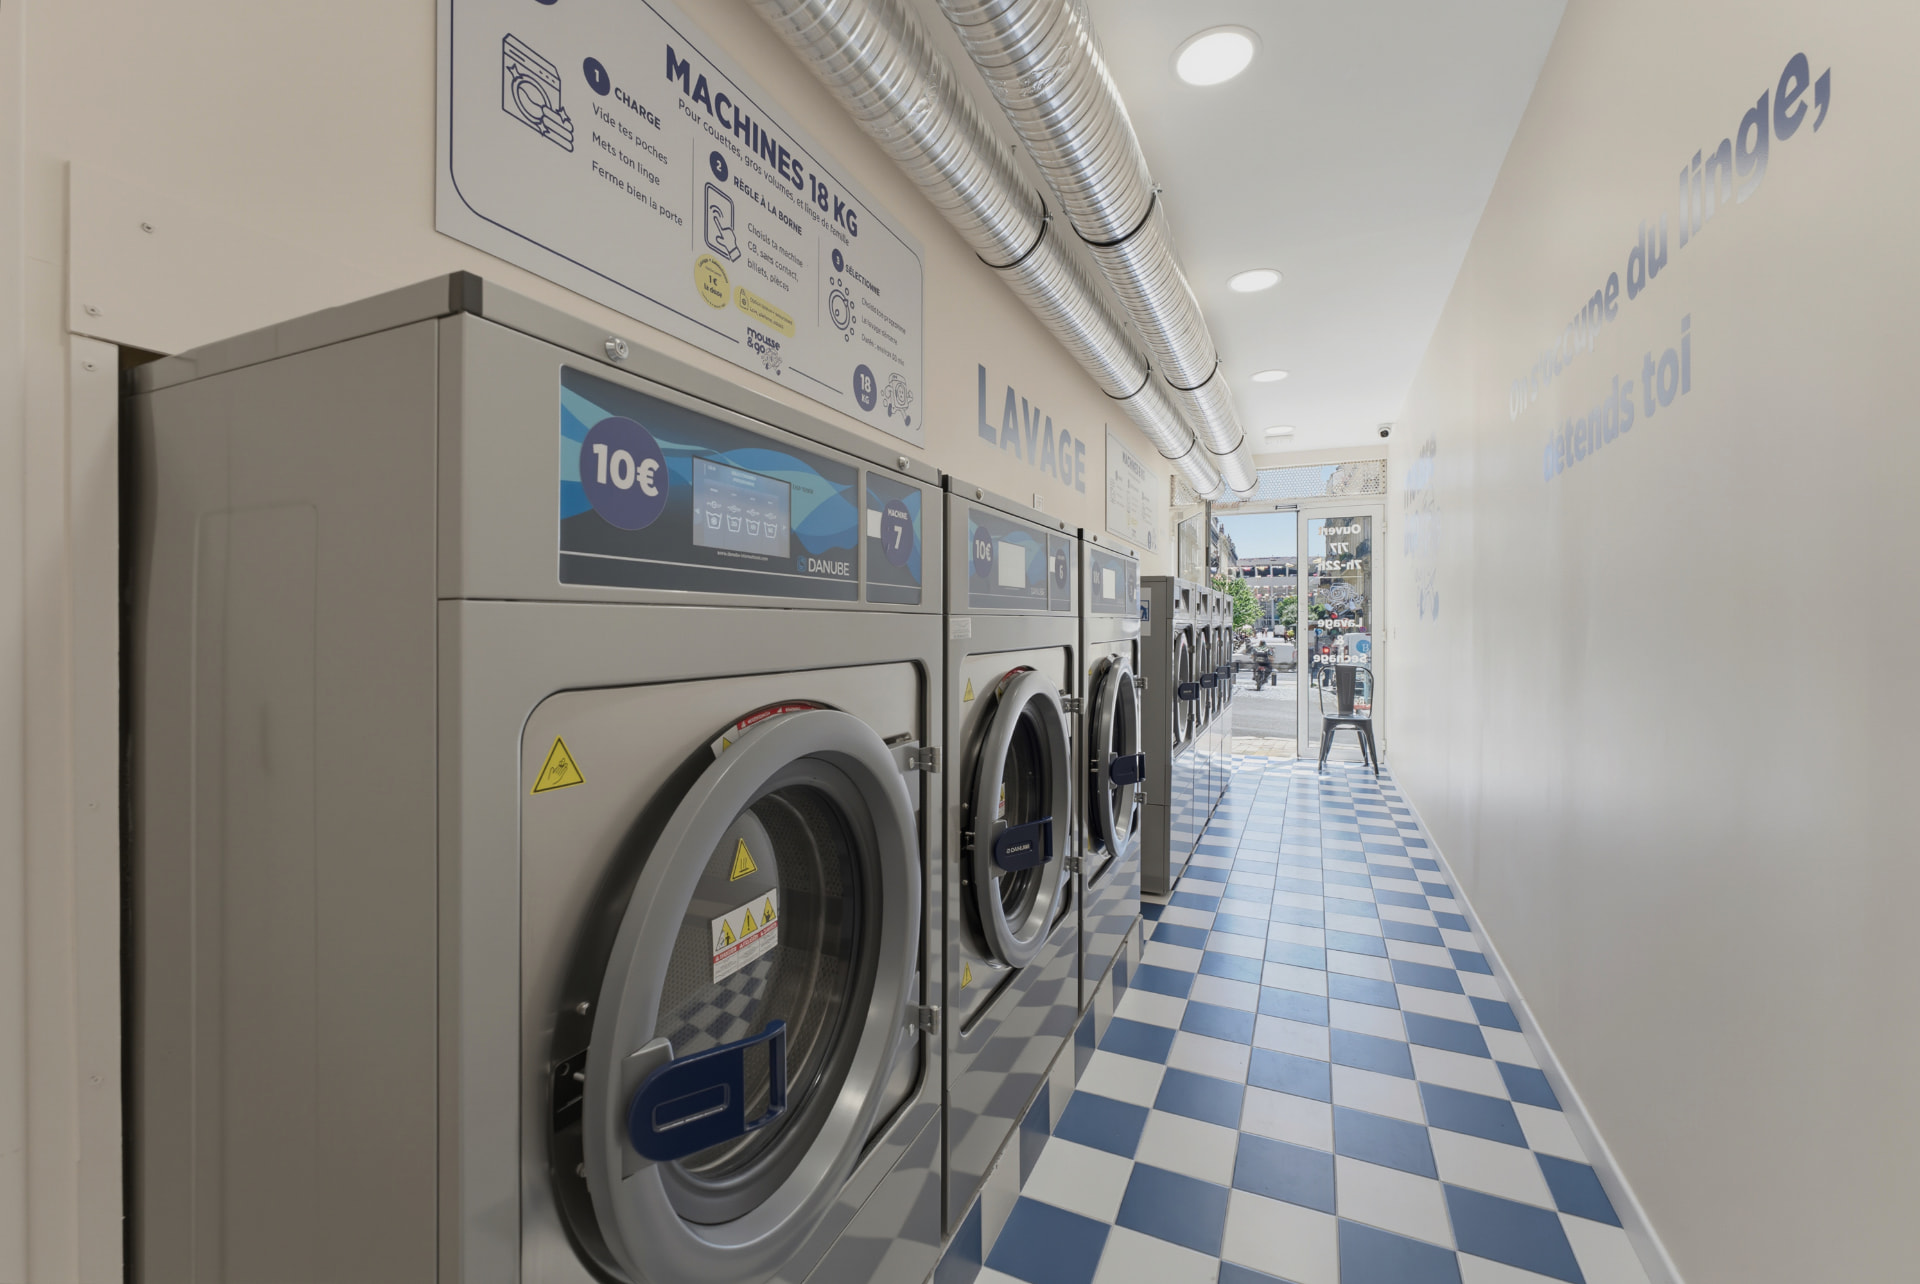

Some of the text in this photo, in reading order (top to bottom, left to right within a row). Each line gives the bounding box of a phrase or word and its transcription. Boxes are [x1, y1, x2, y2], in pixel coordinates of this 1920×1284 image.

[594, 69, 600, 82] 1
[614, 87, 661, 130] CHARGE
[592, 102, 668, 165] Vide tes poches
[666, 43, 858, 237] MACHINES 18 KG
[592, 131, 660, 186] Mets ton linge
[679, 97, 850, 246] Pour couettes, gros volumes, et linge de famille
[716, 160, 722, 172] 2
[1627, 210, 1668, 300] du
[1679, 52, 1831, 250] linge,
[592, 160, 683, 226] Ferme bien la porte
[734, 176, 759, 203] RÈGLE
[768, 202, 777, 216] LA
[779, 210, 802, 236] BORNE
[760, 251, 774, 265] sans
[772, 239, 778, 250] ta
[779, 246, 803, 267] machine
[748, 258, 768, 280] billets,
[747, 326, 780, 351] mousse
[860, 373, 871, 393] 18
[1543, 312, 1691, 482] détends toi
[861, 393, 870, 405] KG
[978, 363, 1085, 494] LAVAGE
[593, 443, 660, 497] 10€
[888, 508, 908, 520] MACHINE
[894, 525, 902, 550] 7
[975, 539, 991, 561] 10€
[808, 558, 849, 576] DANUBE
